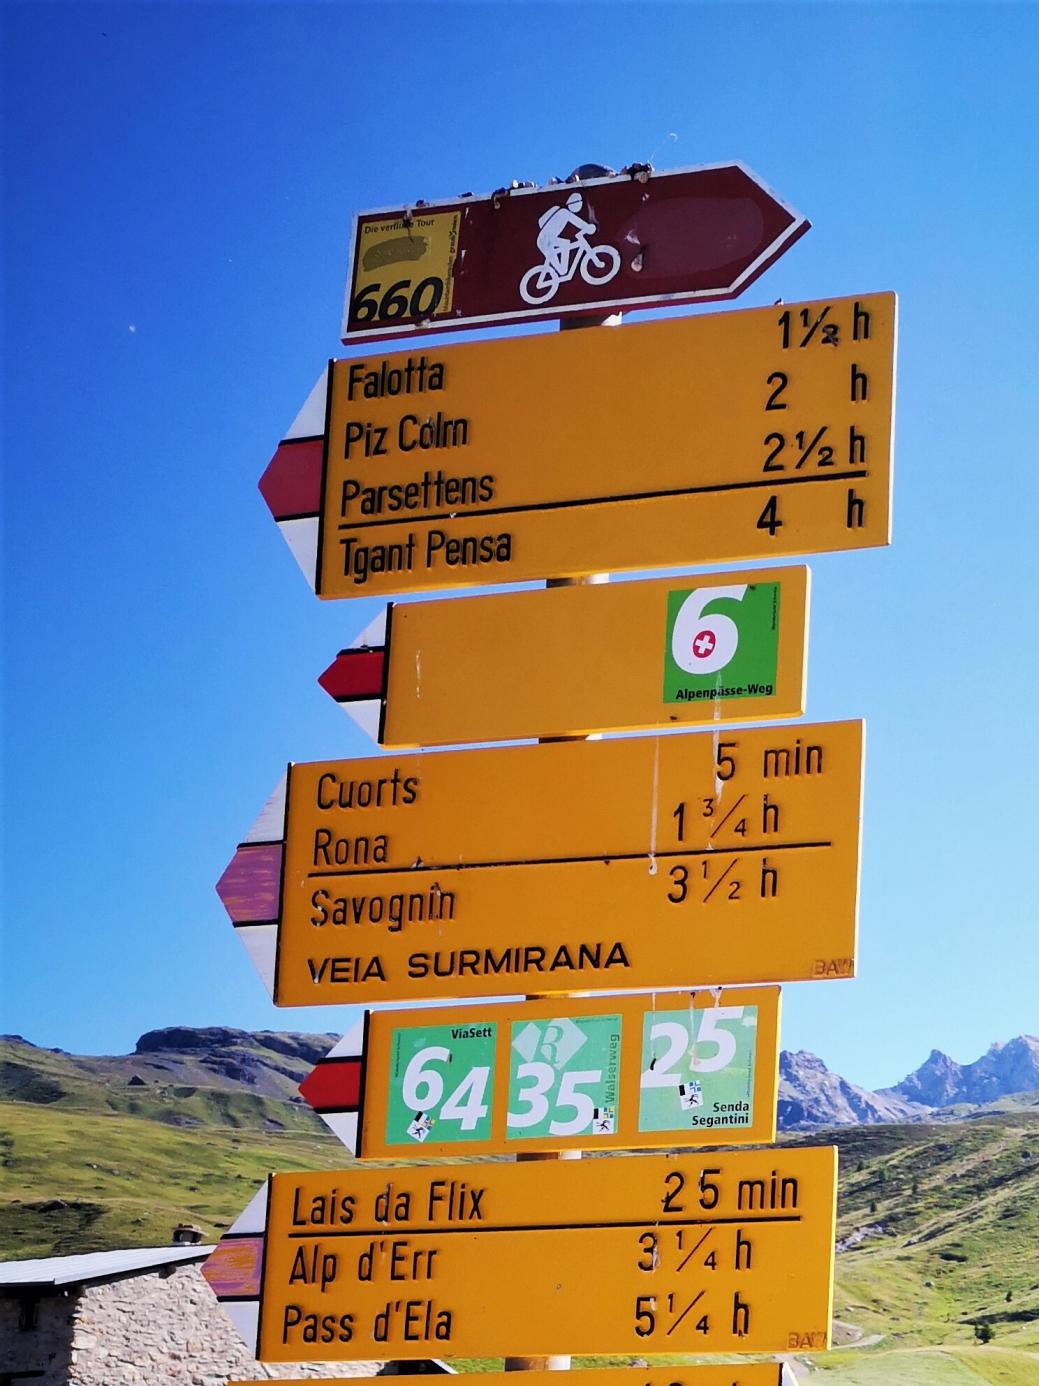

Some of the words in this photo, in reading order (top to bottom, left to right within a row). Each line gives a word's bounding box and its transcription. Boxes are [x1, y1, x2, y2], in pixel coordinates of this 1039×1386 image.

[364, 224, 378, 234] Die
[417, 218, 435, 228] Tour
[350, 276, 444, 321] 660
[347, 356, 444, 401] Falotta
[853, 301, 870, 341] h
[344, 422, 389, 460] Piz
[398, 411, 469, 452] Colm
[765, 371, 788, 411] 2
[850, 363, 868, 402] h
[341, 470, 495, 517] Parsettens
[849, 425, 865, 464] h
[339, 533, 416, 585] Tgant
[426, 529, 512, 568] Pensa
[757, 495, 783, 536] 4
[846, 488, 864, 529] h
[672, 583, 748, 675] 6
[675, 683, 774, 702] Alpenpässe-Weg
[317, 768, 418, 810] Cuorts
[716, 742, 737, 781] 5
[763, 739, 823, 778] min
[313, 828, 389, 866] Rona
[762, 793, 779, 834] h
[310, 882, 455, 933] Savognin
[760, 857, 777, 898] h
[307, 955, 387, 984] VEIA
[407, 941, 631, 979] SURMIRANA
[451, 1027, 492, 1040] ViaSett
[604, 1033, 620, 1104] Walserweg
[640, 1006, 745, 1089] 25
[402, 1045, 491, 1131] 64
[506, 1061, 602, 1136] 35
[692, 1113, 749, 1128] Segantini
[713, 1101, 750, 1113] Senda
[292, 1187, 356, 1226] Lais
[375, 1183, 411, 1223] da
[428, 1181, 485, 1222] Flix
[662, 1169, 721, 1213] 25
[738, 1170, 799, 1210] min
[288, 1244, 338, 1293] Alp
[358, 1240, 440, 1281] d'Err
[735, 1229, 752, 1270] h
[283, 1304, 355, 1344] Pass
[374, 1300, 452, 1342] d'Ela
[732, 1291, 750, 1335] h
